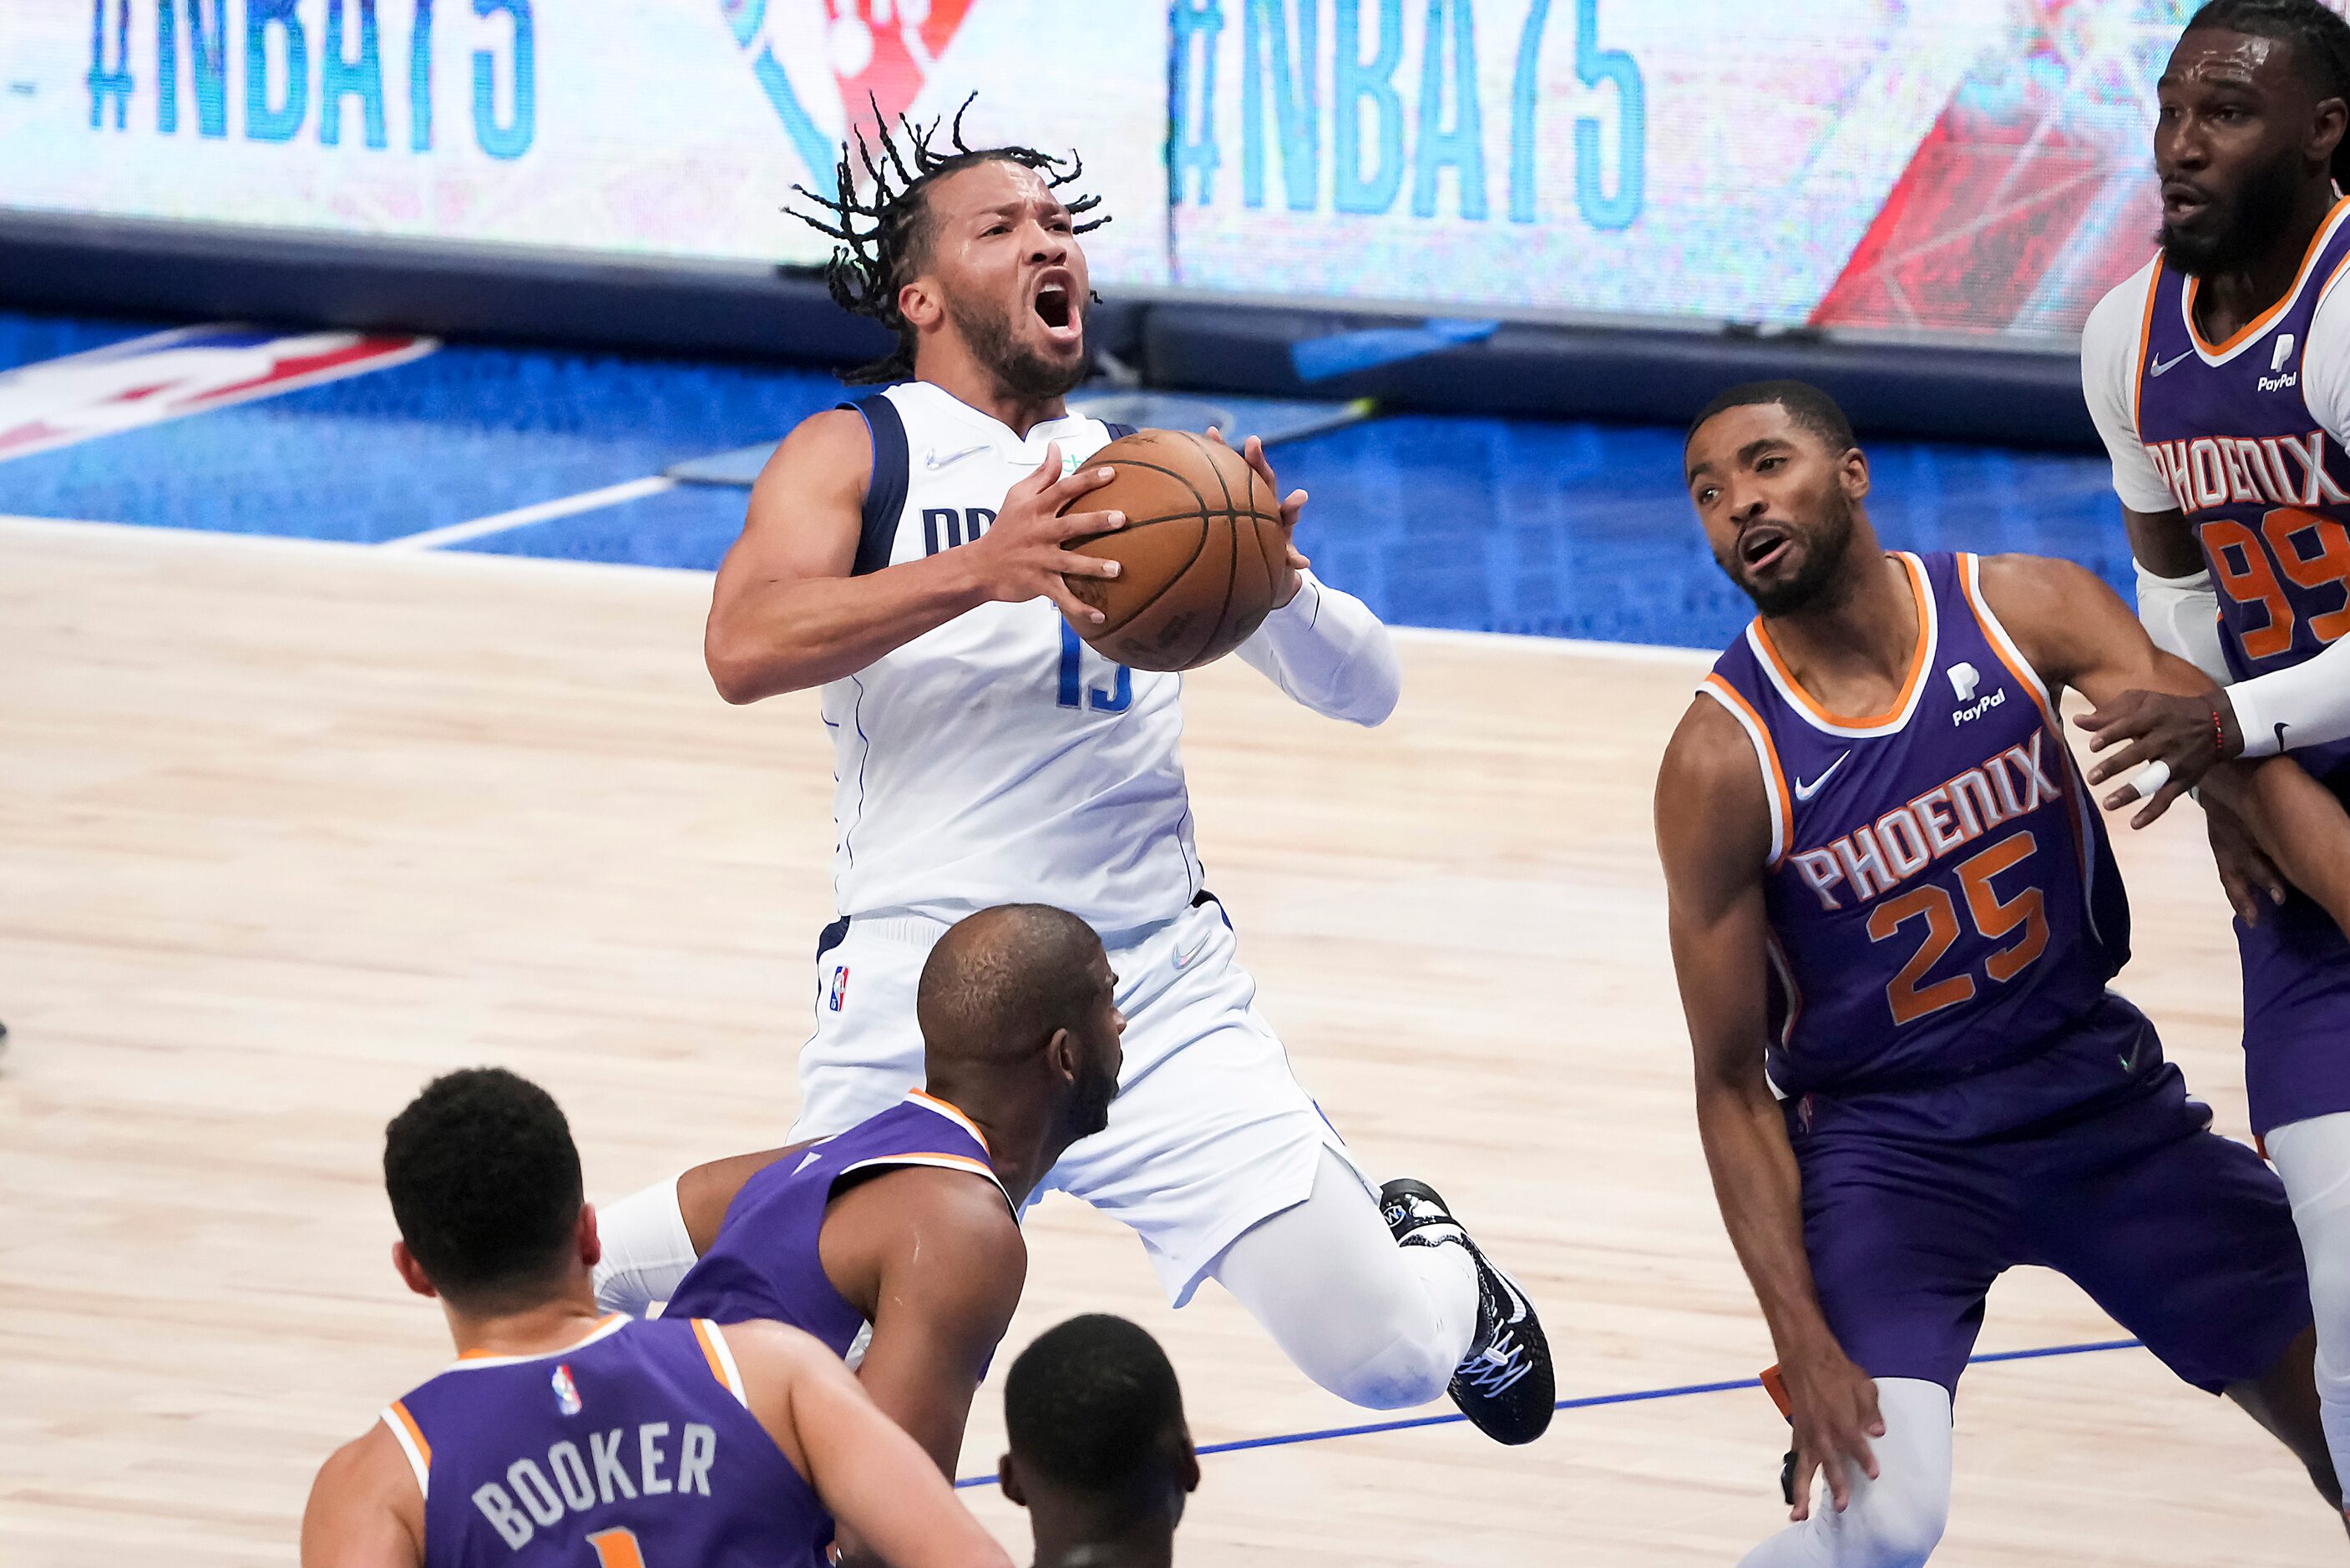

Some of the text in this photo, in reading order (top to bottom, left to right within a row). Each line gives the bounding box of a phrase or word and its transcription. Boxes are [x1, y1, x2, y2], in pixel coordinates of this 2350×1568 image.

[1164, 0, 1645, 230] #NBA75
[2257, 372, 2297, 392] PayPal
[2144, 429, 2350, 516] PHOENIX
[2201, 507, 2350, 660] 99
[1952, 687, 2005, 726] PayPal
[1790, 727, 2061, 910] PHOENIX
[1866, 830, 2049, 1025] 25
[472, 1423, 716, 1550] BOOKER
